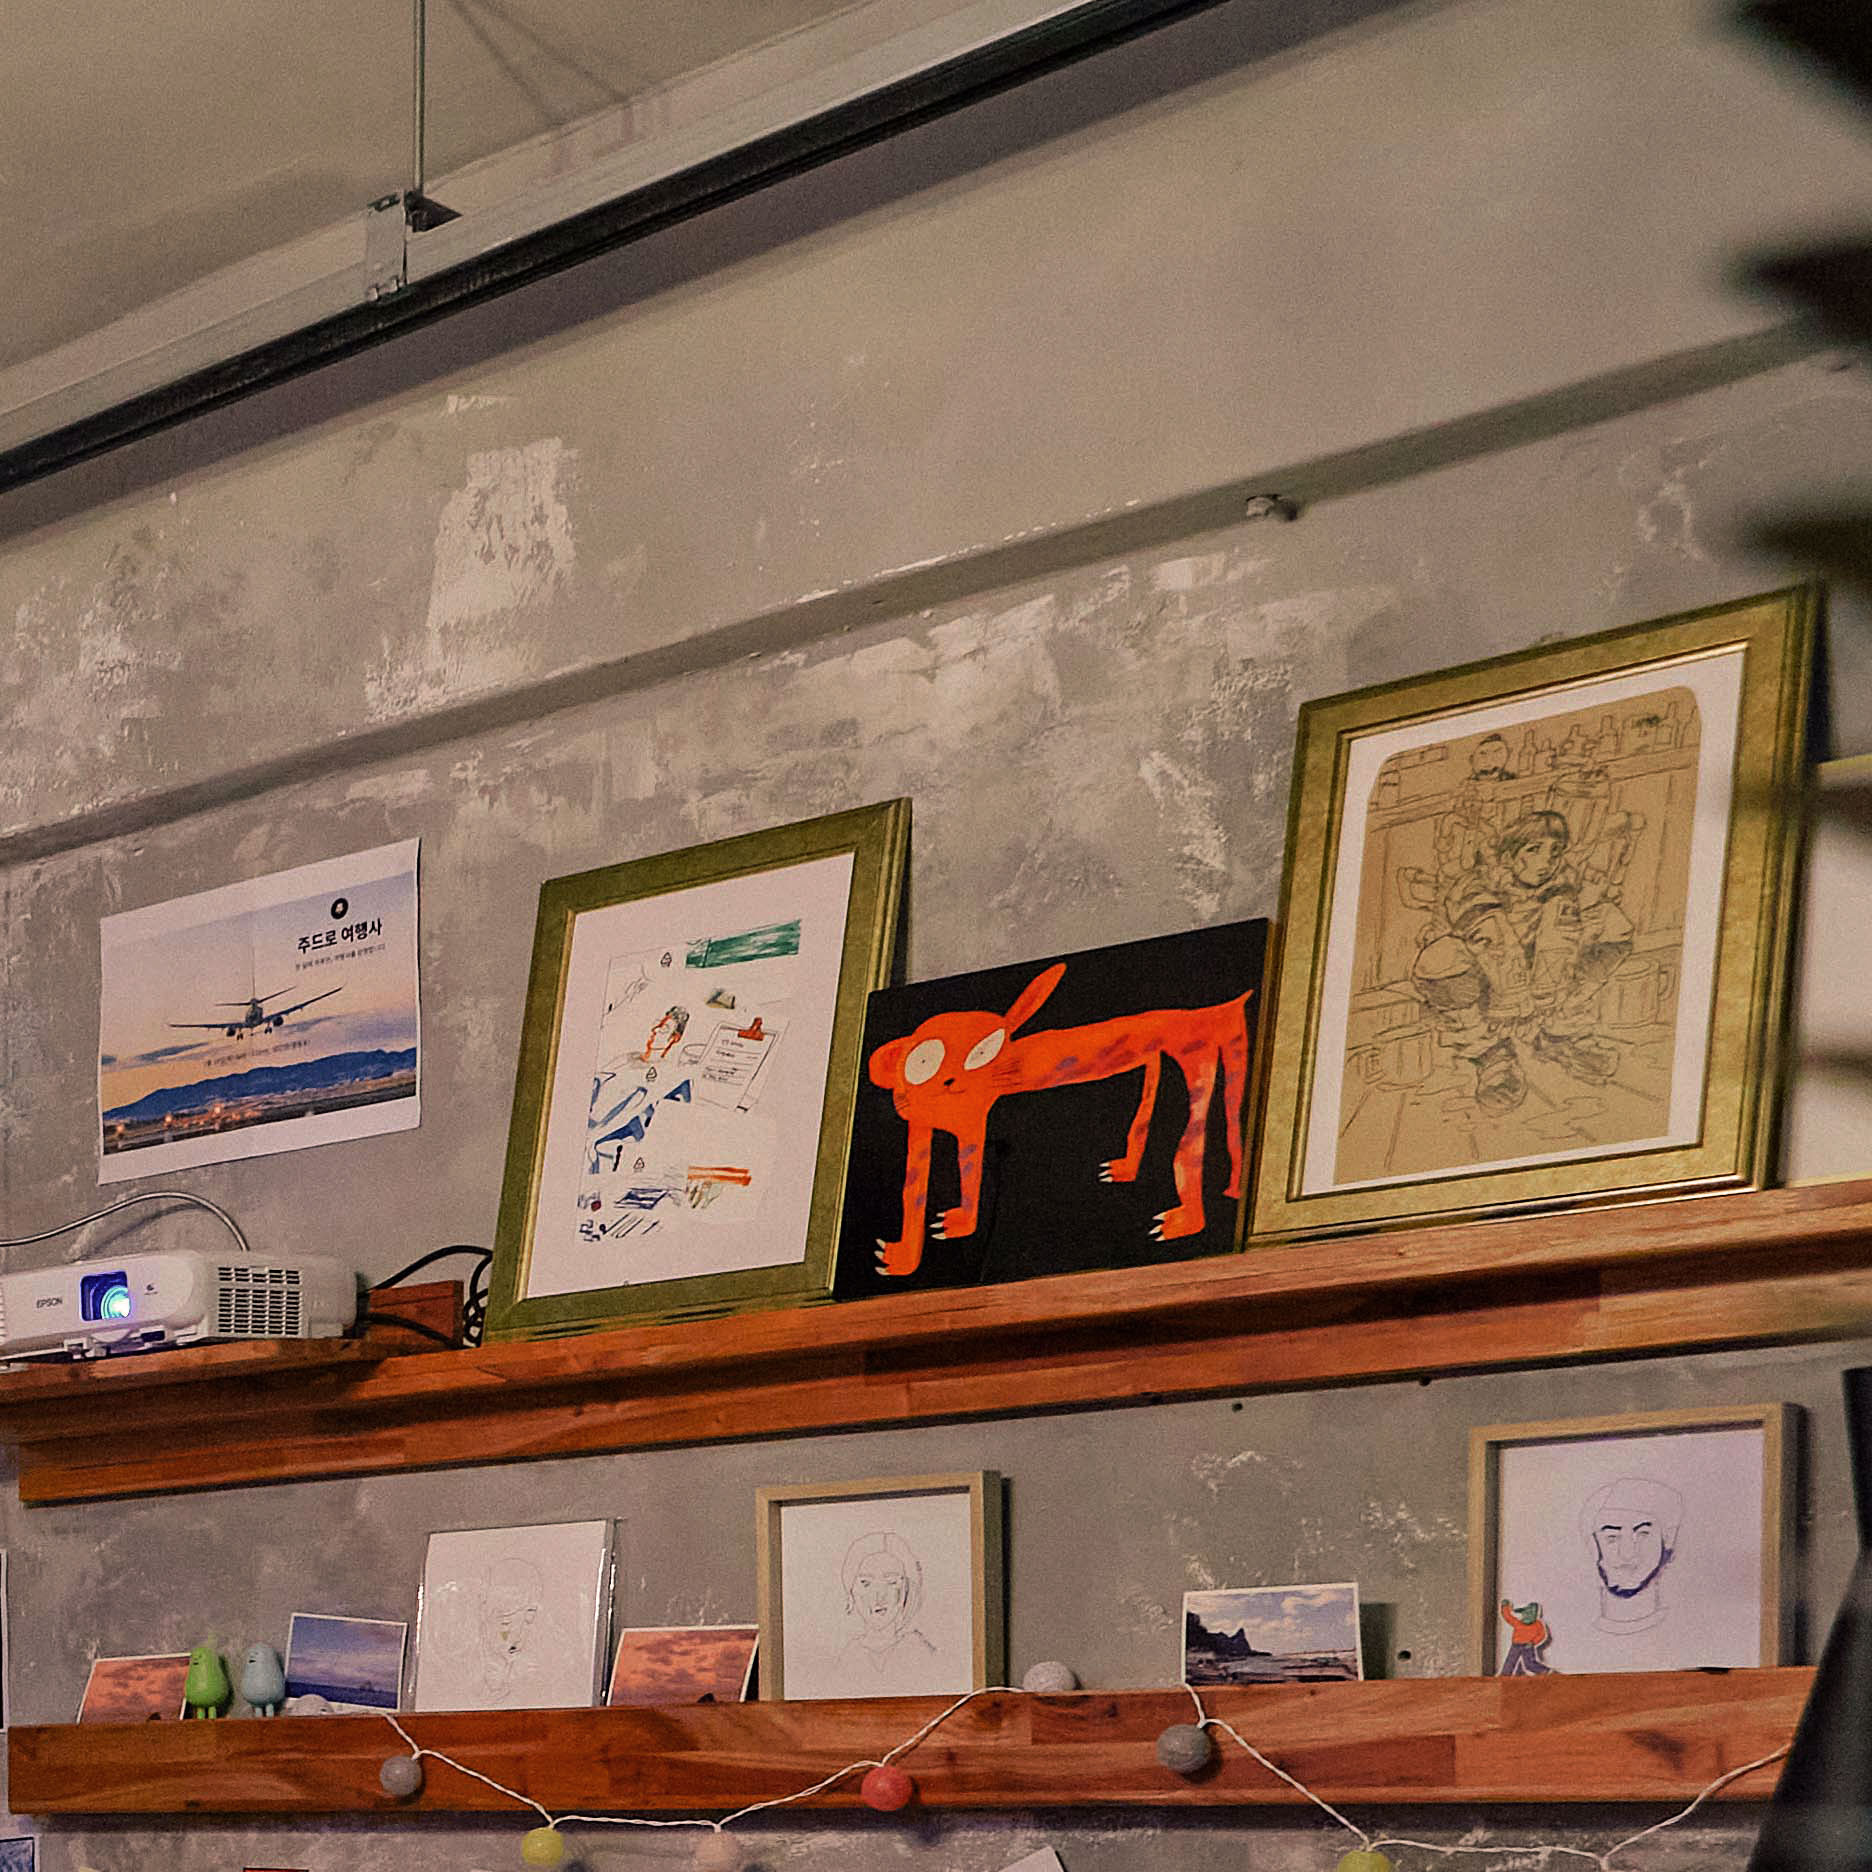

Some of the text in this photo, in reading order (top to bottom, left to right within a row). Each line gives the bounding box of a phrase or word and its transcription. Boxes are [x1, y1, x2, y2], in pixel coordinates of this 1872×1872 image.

[298, 917, 383, 955] 주드로 여행사
[36, 1296, 64, 1310] EPSON
